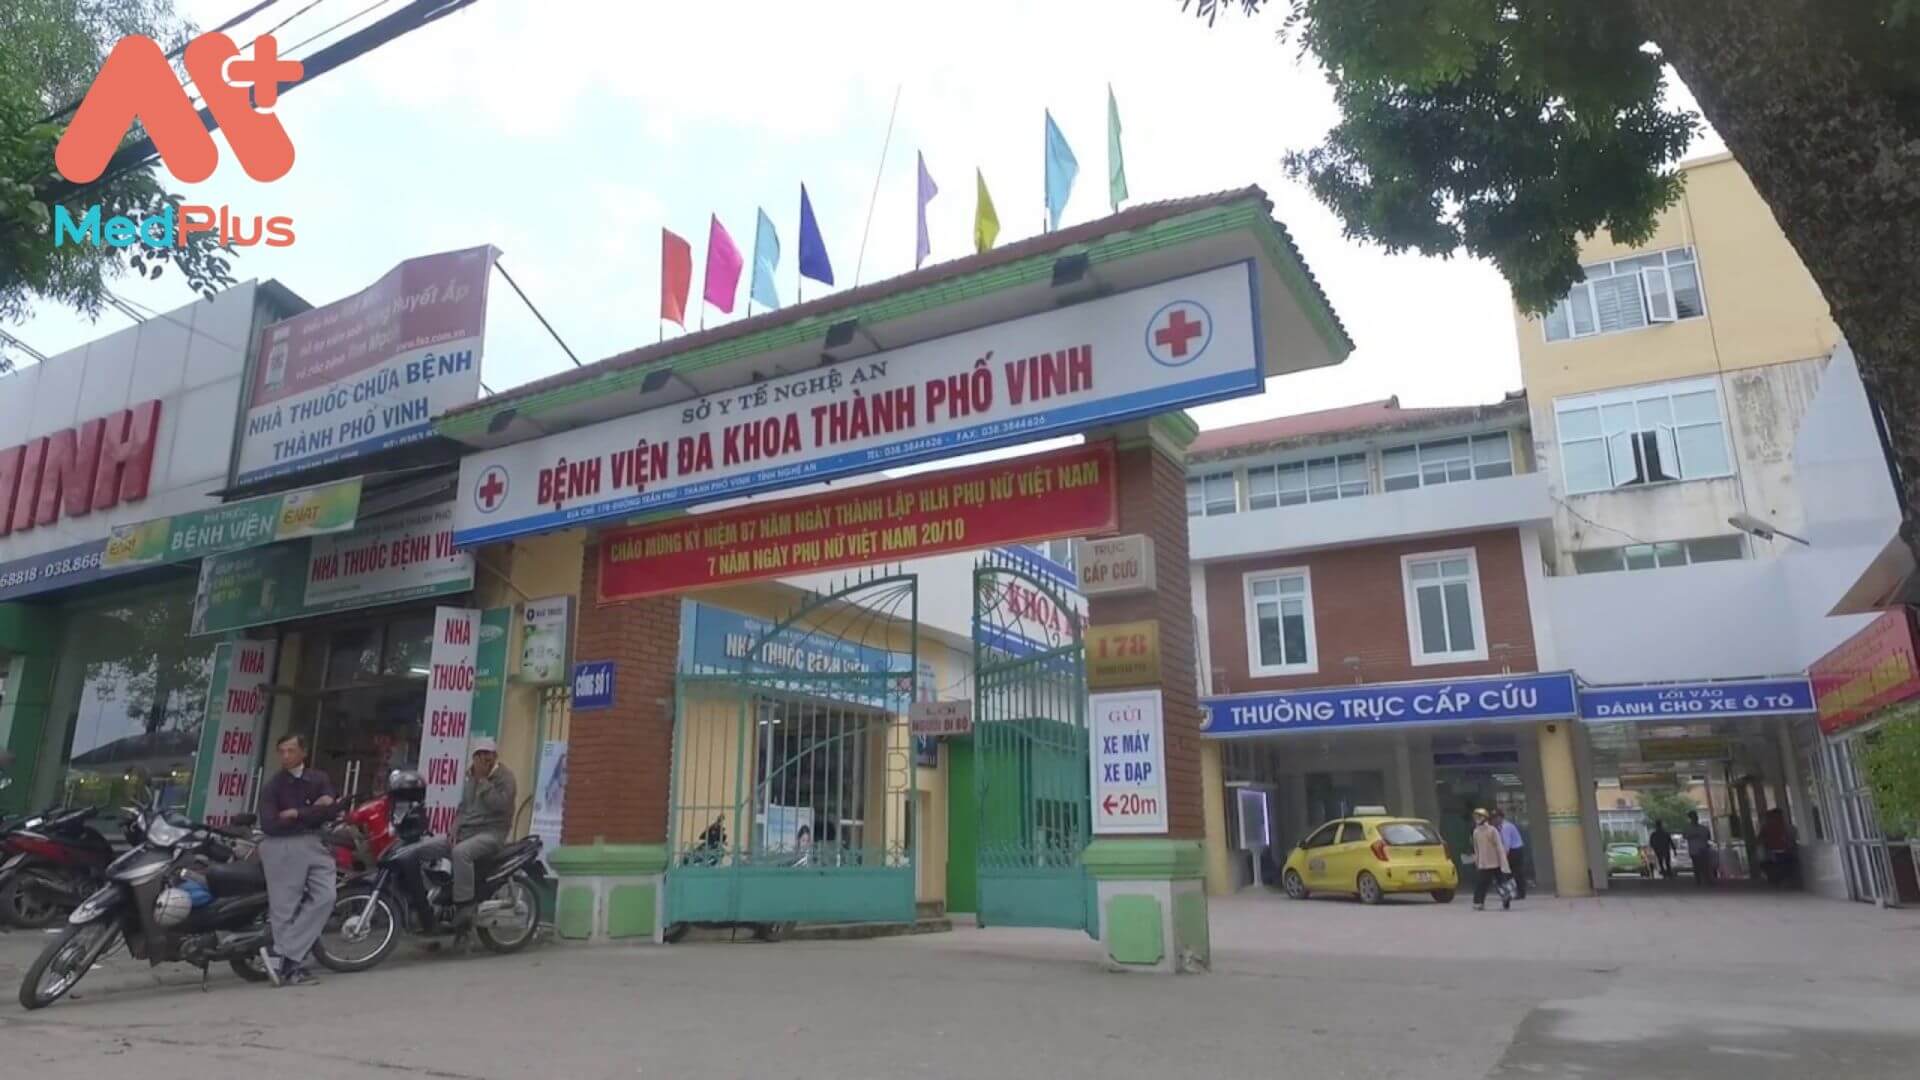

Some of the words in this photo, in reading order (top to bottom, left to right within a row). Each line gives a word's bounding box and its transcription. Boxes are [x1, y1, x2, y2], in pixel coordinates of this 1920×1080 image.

[249, 406, 282, 436] NHÀ
[290, 382, 348, 424] THUỐC
[353, 369, 400, 403] CHỮA
[406, 350, 472, 384] BỆNH
[682, 398, 711, 424] SỞ
[717, 400, 734, 415] Y
[738, 384, 769, 409] TẾ
[774, 368, 842, 402] NGHỆ
[849, 361, 888, 384] AN
[273, 424, 333, 461] THÀNH
[339, 403, 378, 443] PHỐ
[383, 397, 429, 429] VINH
[537, 456, 601, 510] BỆNH
[611, 438, 669, 493] VIỆN
[677, 431, 714, 476] ĐA
[722, 412, 802, 467] KHOA
[811, 385, 916, 448] THÀNH
[925, 350, 994, 423] PHỐ
[1004, 344, 1094, 406] VINH
[611, 539, 643, 563] CHÀO
[645, 532, 682, 558] MỪNG
[796, 503, 832, 530] NGÀY
[834, 499, 883, 524] THÀNH
[887, 492, 915, 521] LẬP
[920, 489, 950, 512] HLH
[953, 480, 985, 509] PHỤ
[990, 472, 1014, 501] NỮ
[1018, 465, 1053, 498] VIỆT
[1058, 460, 1099, 489] NAM
[171, 522, 223, 551] BỆNH
[230, 512, 274, 543] VIỆN
[707, 557, 716, 577] 7
[753, 544, 789, 570] NGÀY
[793, 542, 821, 568] PHỤ
[824, 535, 845, 560] NỮ
[847, 527, 877, 560] VIỆT
[882, 524, 918, 549] NAM
[922, 517, 965, 546] 20/10
[311, 545, 339, 582] NHÀ
[343, 536, 388, 577] THUỐC
[391, 533, 431, 571] BỆNH
[1083, 557, 1108, 584] CẤP
[444, 613, 470, 646] NHÀ
[1097, 633, 1149, 660] 178
[240, 646, 265, 673] NHÀ
[432, 656, 474, 692] THUỐC
[1231, 698, 1334, 725] THƯỜNG
[1340, 695, 1405, 722] TRỰC
[1413, 686, 1471, 714] CẤP
[1479, 682, 1538, 711] CỨU
[1660, 700, 1703, 713] CHO
[1710, 698, 1738, 711] XE
[1743, 694, 1759, 709] Ô
[1765, 693, 1794, 708] TÔ
[1690, 688, 1724, 698] VÀO
[431, 705, 467, 743] BỆNH
[1109, 706, 1142, 723] GỬI
[1104, 736, 1119, 754] XE
[1122, 729, 1150, 753] MÁY
[217, 768, 247, 802] VIỆN
[428, 754, 459, 791] VIỆN
[1104, 763, 1120, 782] XE
[1125, 762, 1152, 787] ĐẠP
[1120, 793, 1157, 815] 20m
